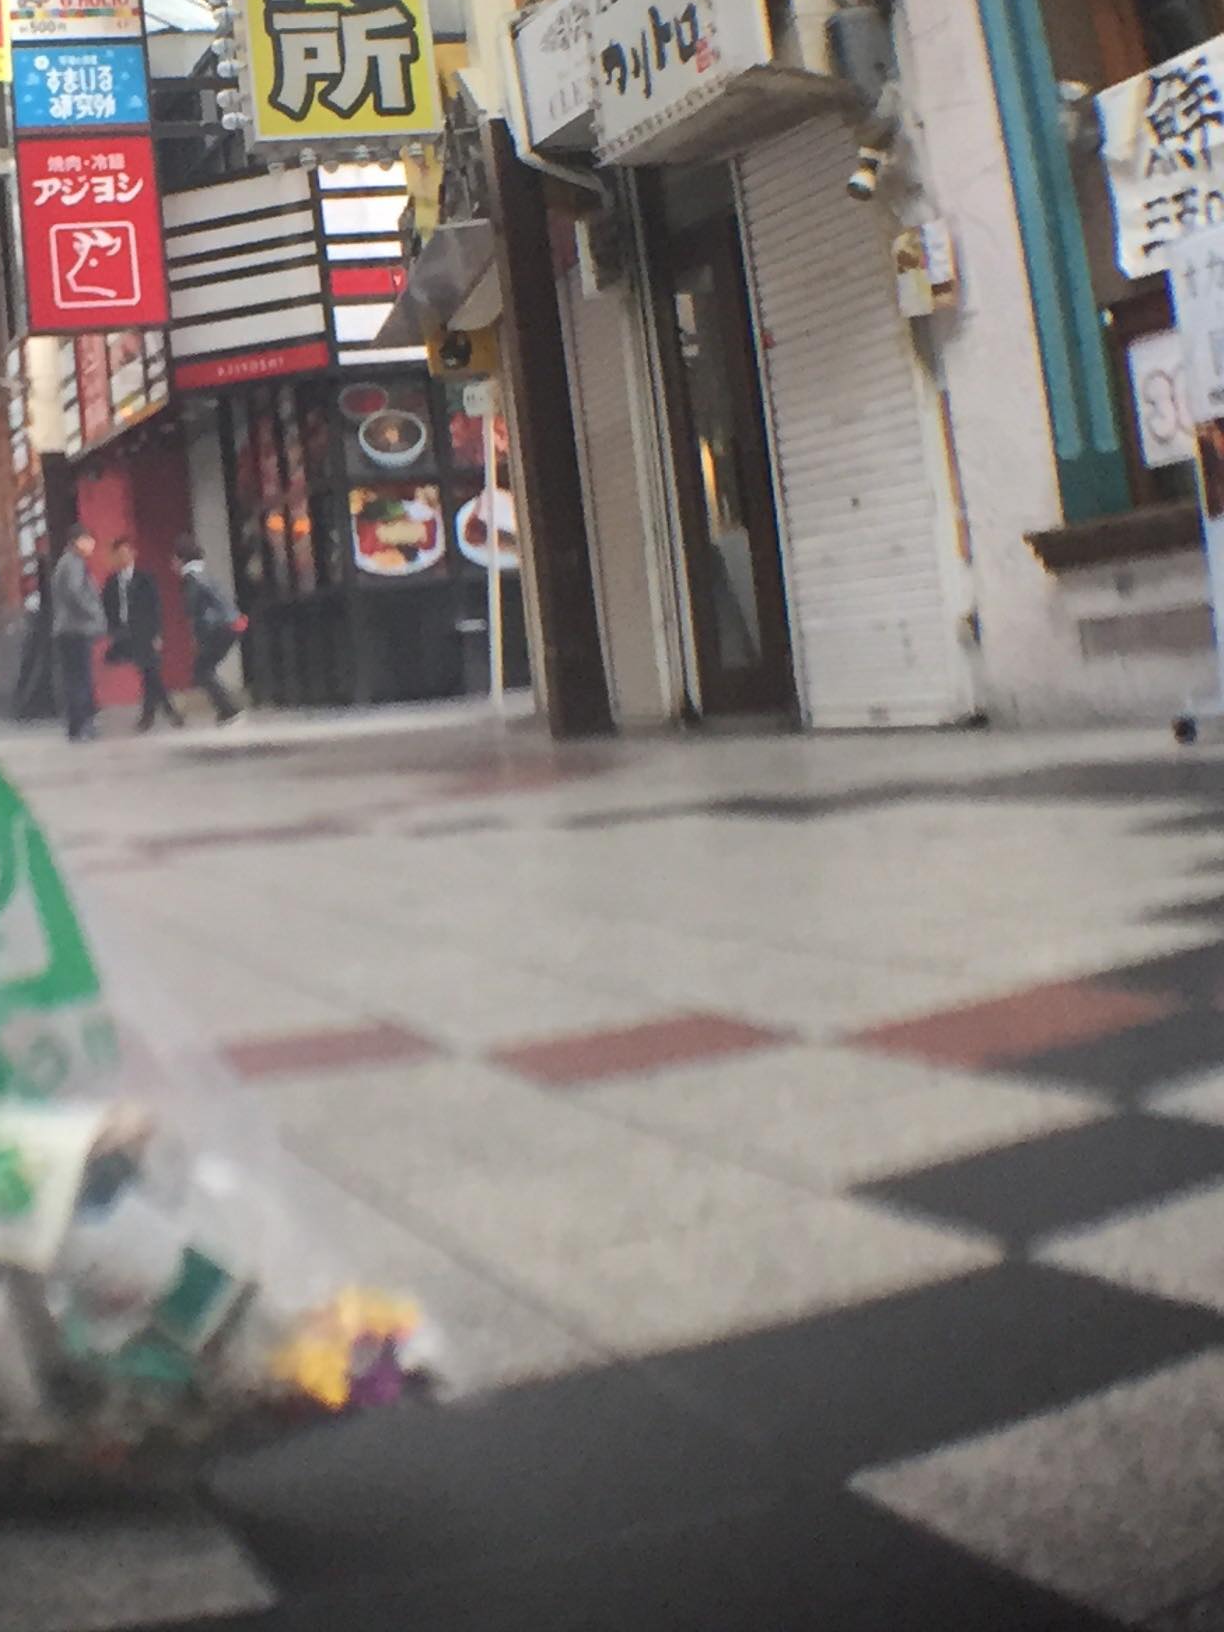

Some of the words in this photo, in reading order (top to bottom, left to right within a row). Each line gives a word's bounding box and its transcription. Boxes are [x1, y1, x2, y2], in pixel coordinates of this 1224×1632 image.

[45, 65, 113, 94] すまいる
[48, 93, 116, 121] 研究所
[31, 171, 145, 206] アジヨシ
